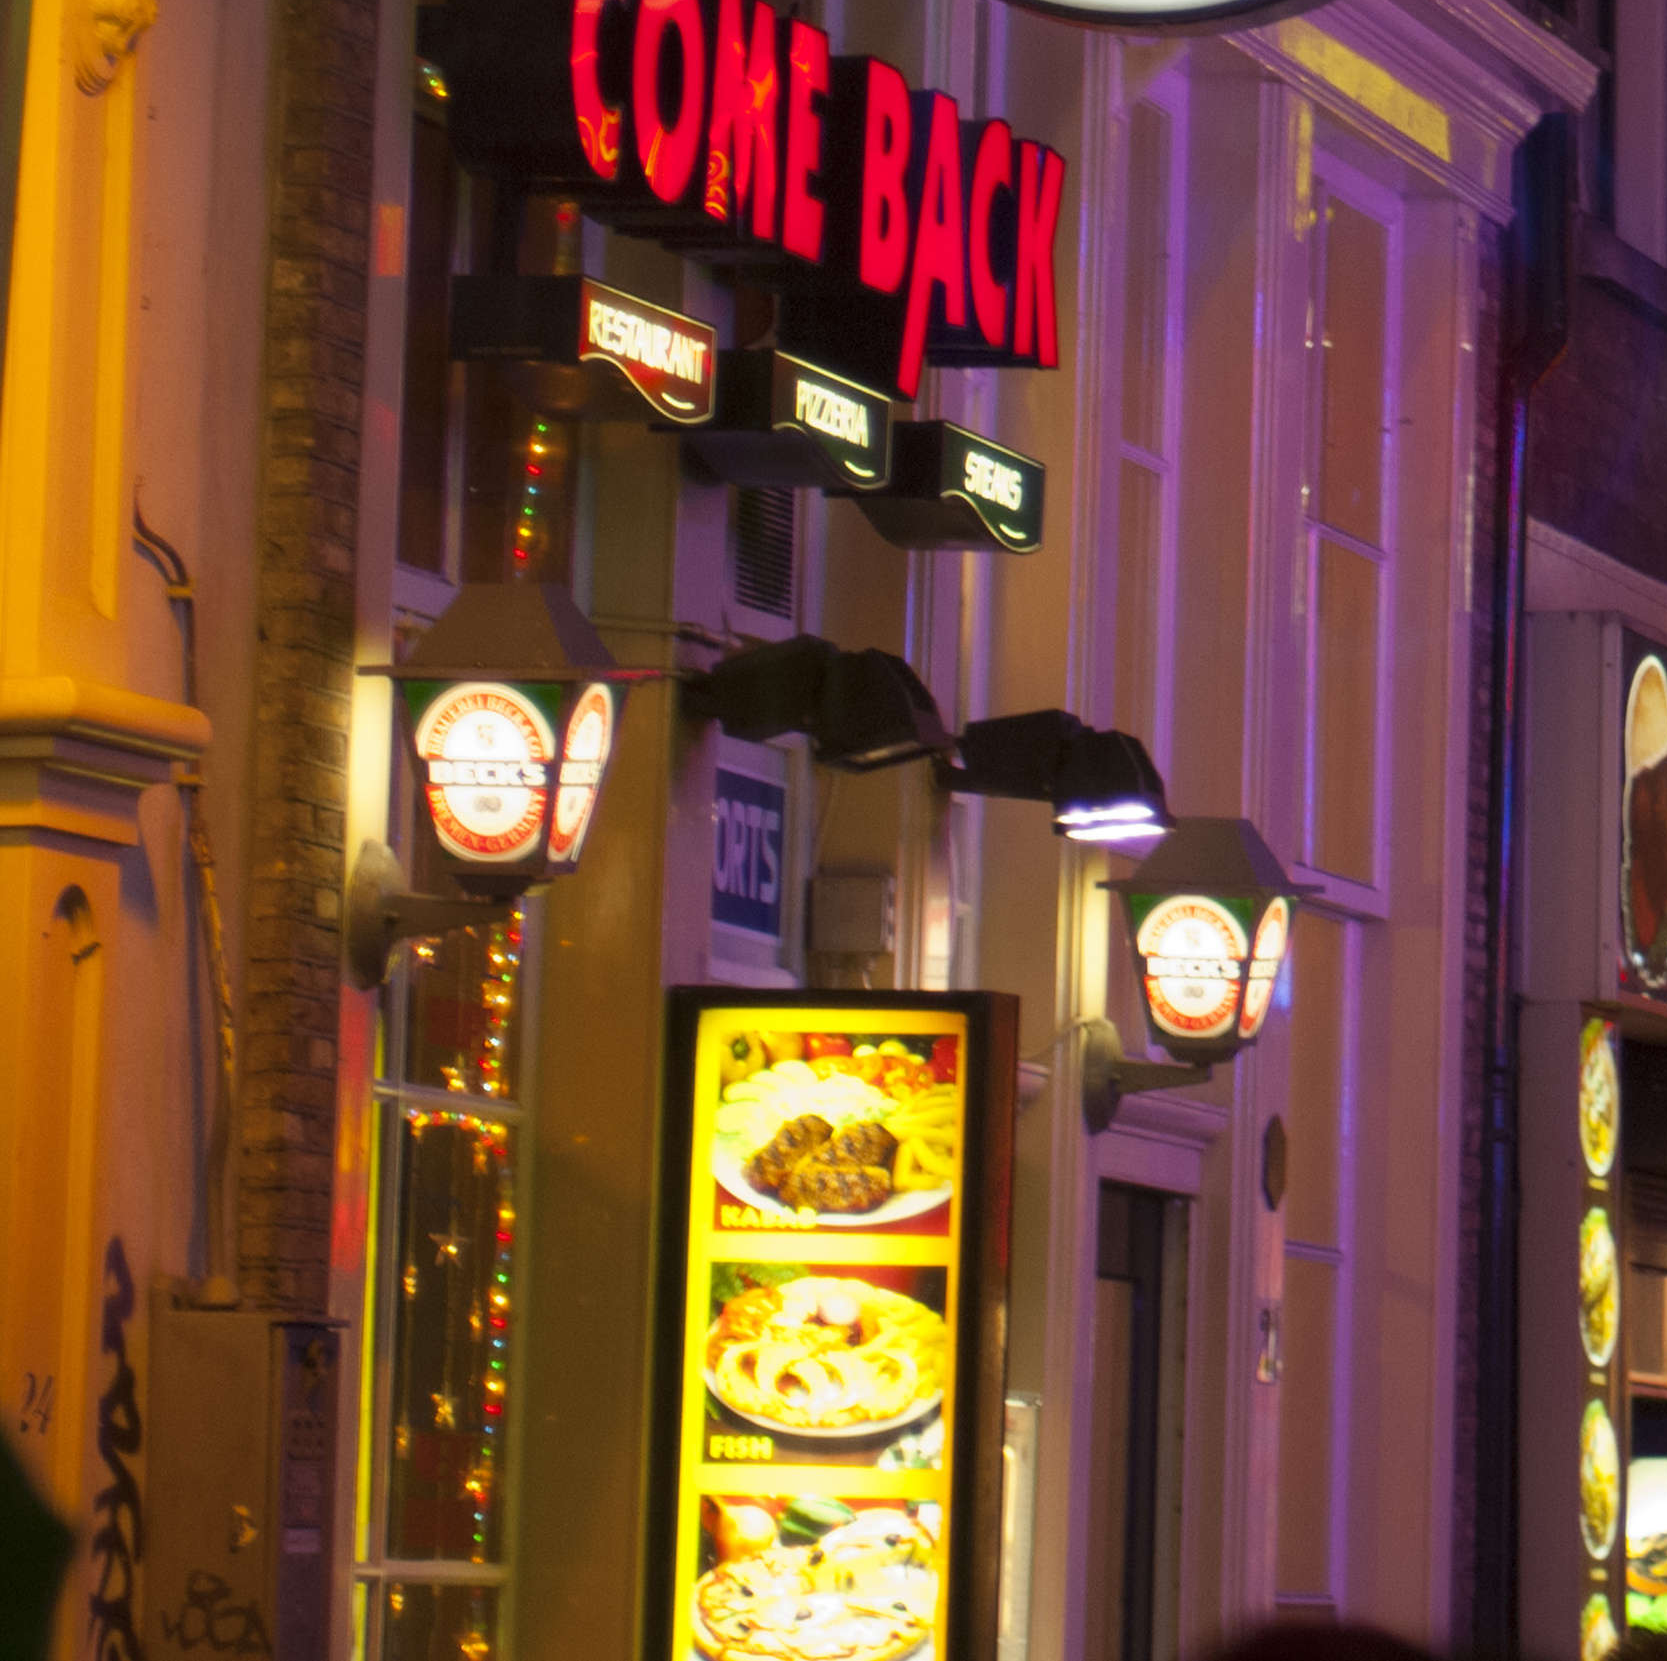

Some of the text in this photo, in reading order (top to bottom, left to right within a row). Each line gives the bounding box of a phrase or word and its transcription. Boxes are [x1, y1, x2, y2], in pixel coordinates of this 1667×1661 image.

[860, 55, 1065, 402] BACK
[588, 300, 707, 385] RESTAURANT
[795, 378, 870, 449] PIZZERIA
[708, 1434, 774, 1460] FISH
